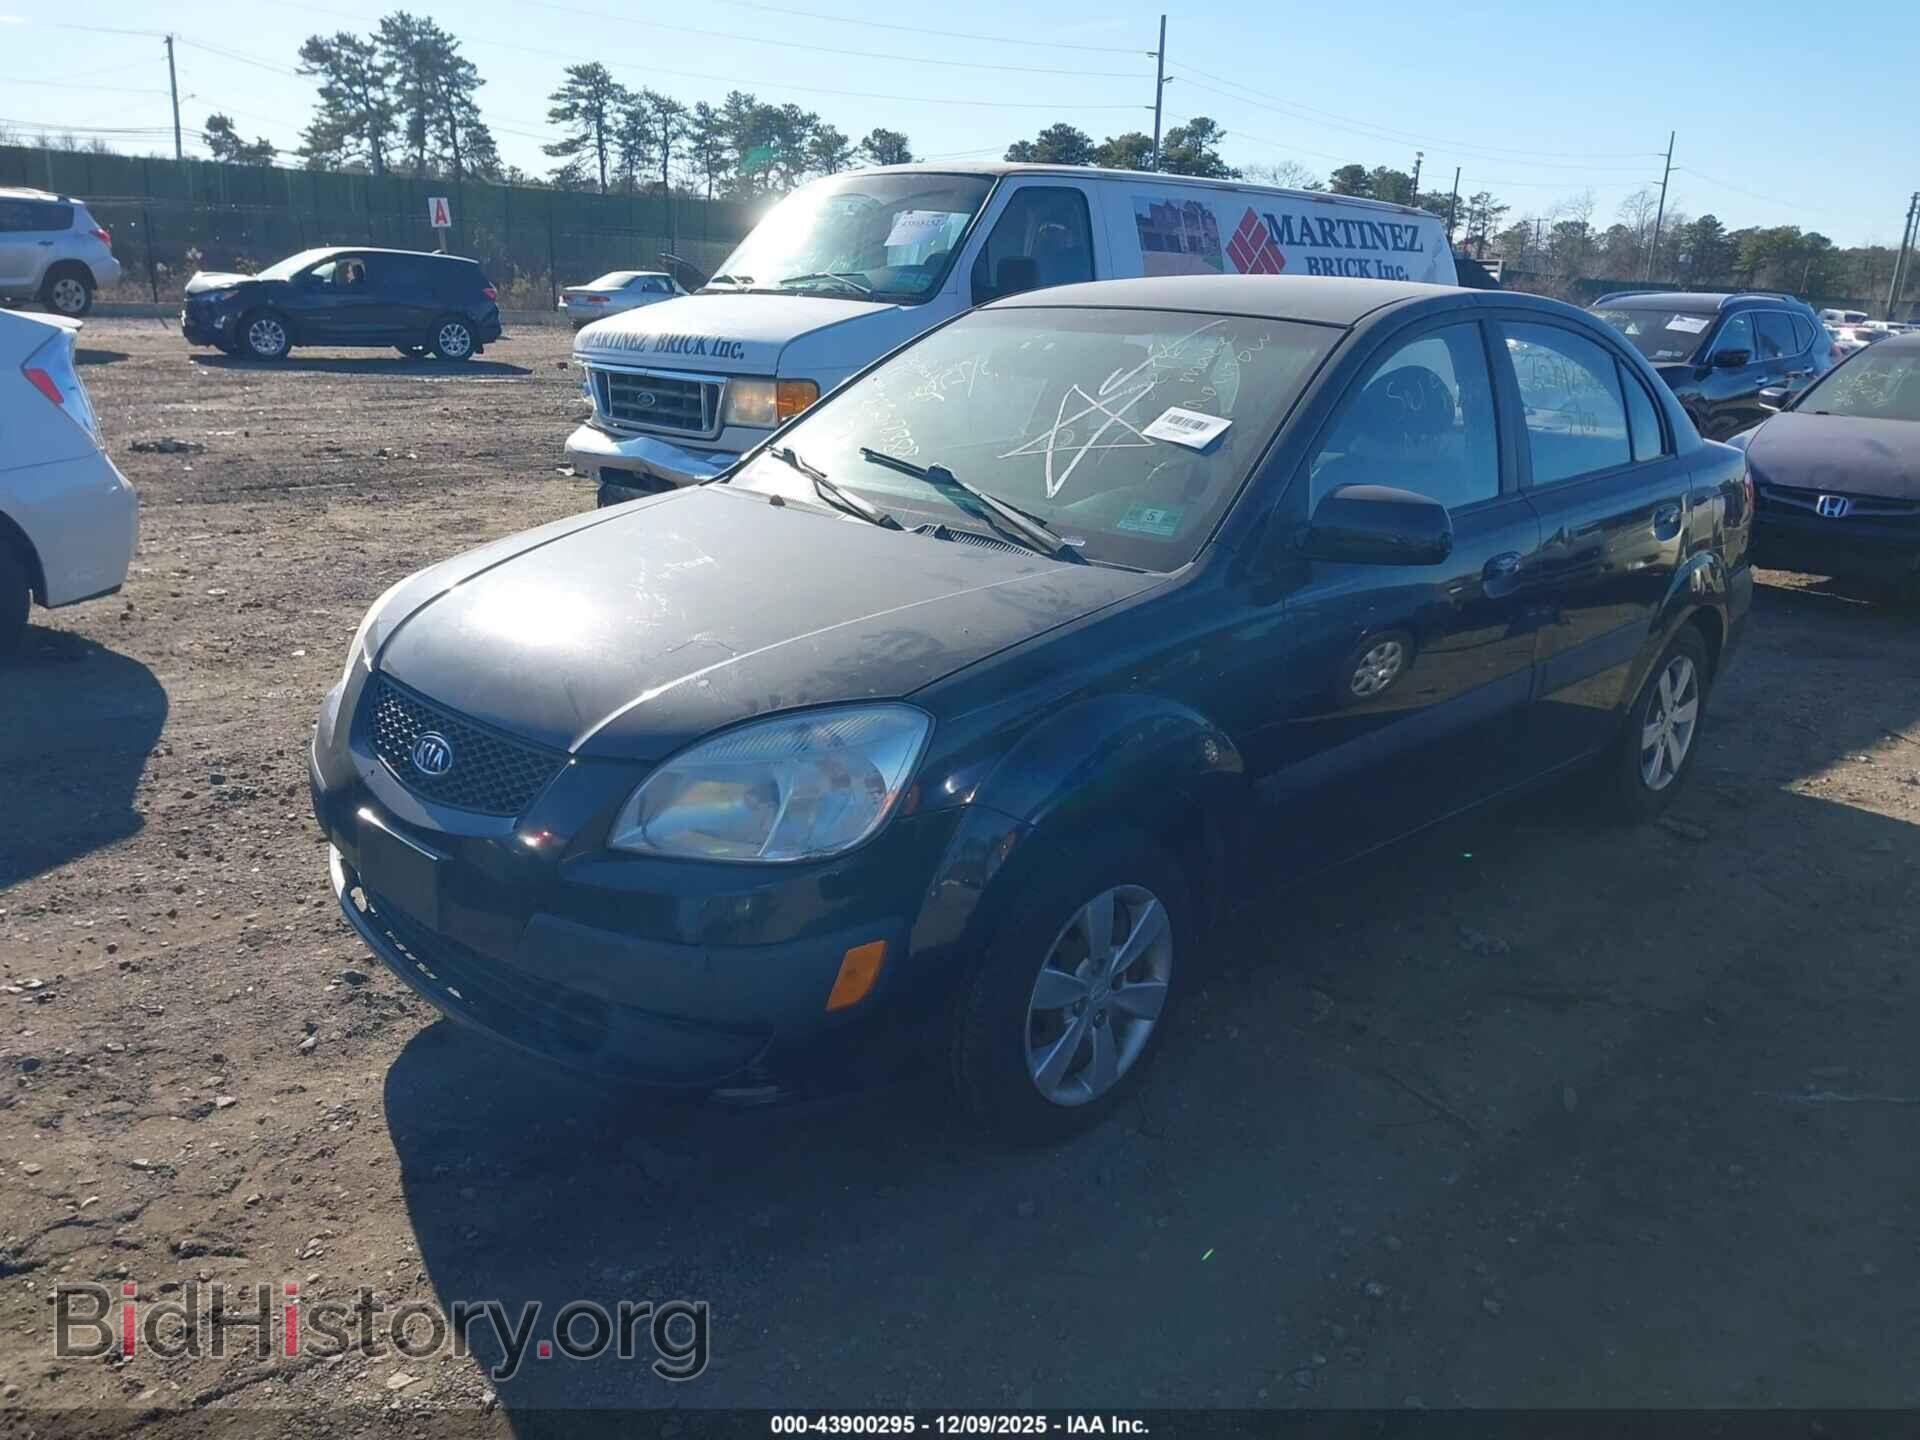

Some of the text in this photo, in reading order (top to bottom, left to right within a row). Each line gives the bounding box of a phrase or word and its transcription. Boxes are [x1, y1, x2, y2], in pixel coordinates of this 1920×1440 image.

[434, 199, 448, 225] A
[1263, 213, 1424, 252] MARTINEZ
[1305, 256, 1410, 281] BRICK Inc.
[652, 332, 709, 356] BRICK
[710, 337, 745, 360] Inc.
